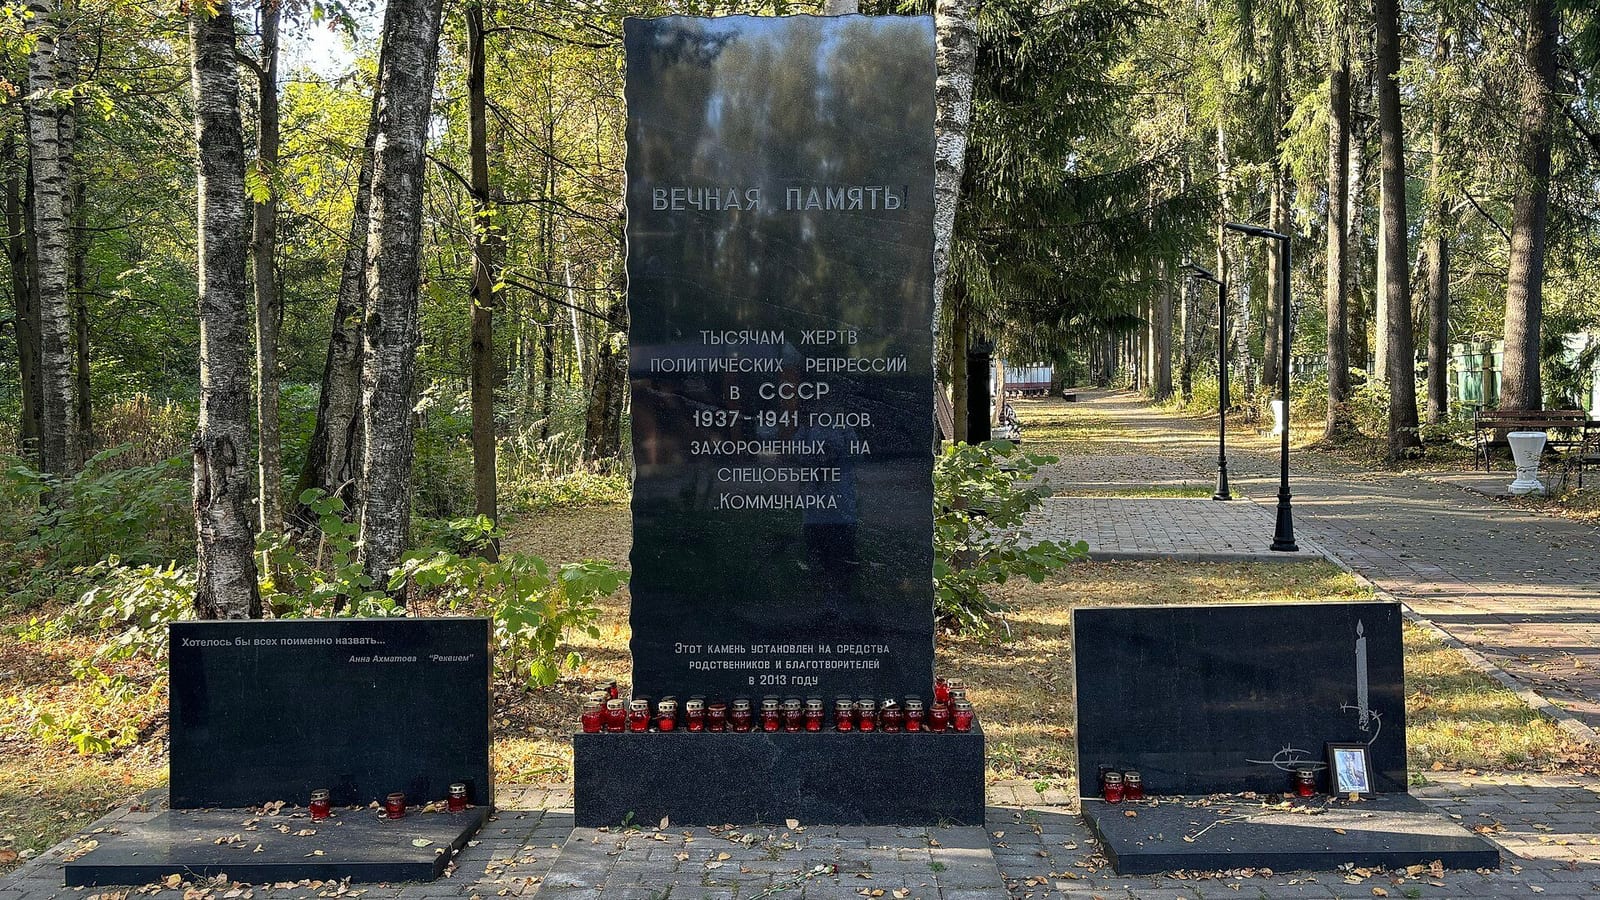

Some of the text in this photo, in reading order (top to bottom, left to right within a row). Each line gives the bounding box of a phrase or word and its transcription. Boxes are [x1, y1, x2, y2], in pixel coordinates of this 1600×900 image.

[652, 186, 761, 211] ВЕЧНАЯ
[700, 330, 858, 345] ТЫСЯЧАМ ЖЕРТВ
[650, 354, 907, 373] ПОЛИТИЧЕСКИХ РЕПРЕССИЙ
[758, 382, 830, 400] СССР
[690, 440, 871, 455] ЗАХОРОНЕННЫХ НА
[717, 467, 841, 484] СПЕЦОБЪЕКТЕ
[181, 637, 232, 648] Хотелось
[234, 636, 251, 647] бы
[253, 638, 278, 647] всех
[279, 638, 334, 647] поименно
